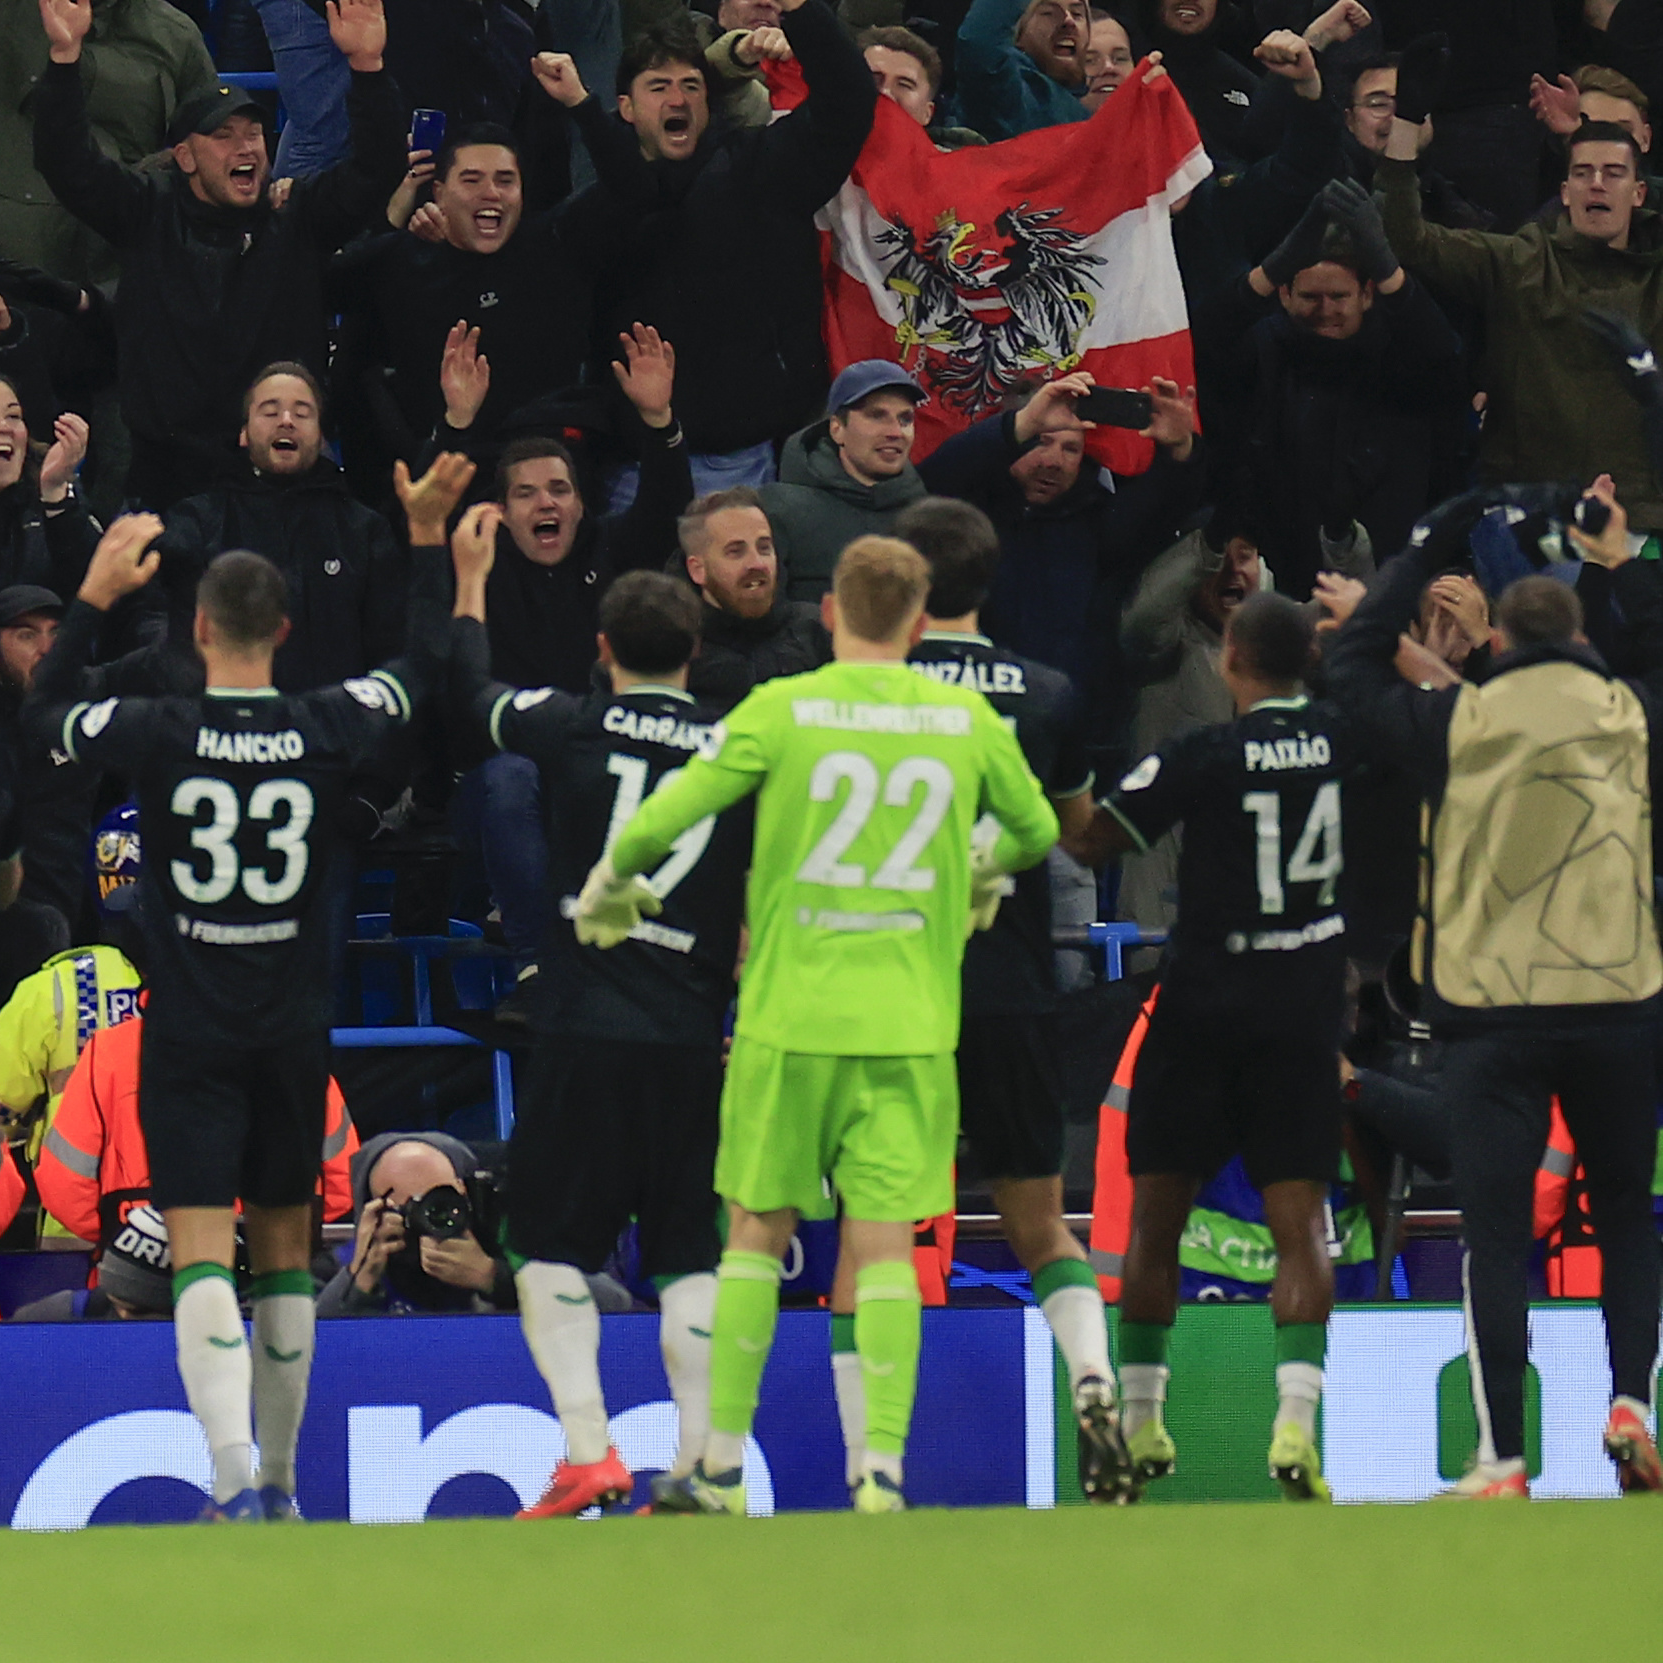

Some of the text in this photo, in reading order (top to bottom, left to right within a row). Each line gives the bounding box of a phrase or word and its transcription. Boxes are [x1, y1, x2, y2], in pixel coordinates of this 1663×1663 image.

[196, 727, 305, 763] HANCKO
[171, 776, 315, 905] 33
[796, 751, 954, 891] 22
[1242, 780, 1344, 915] 14
